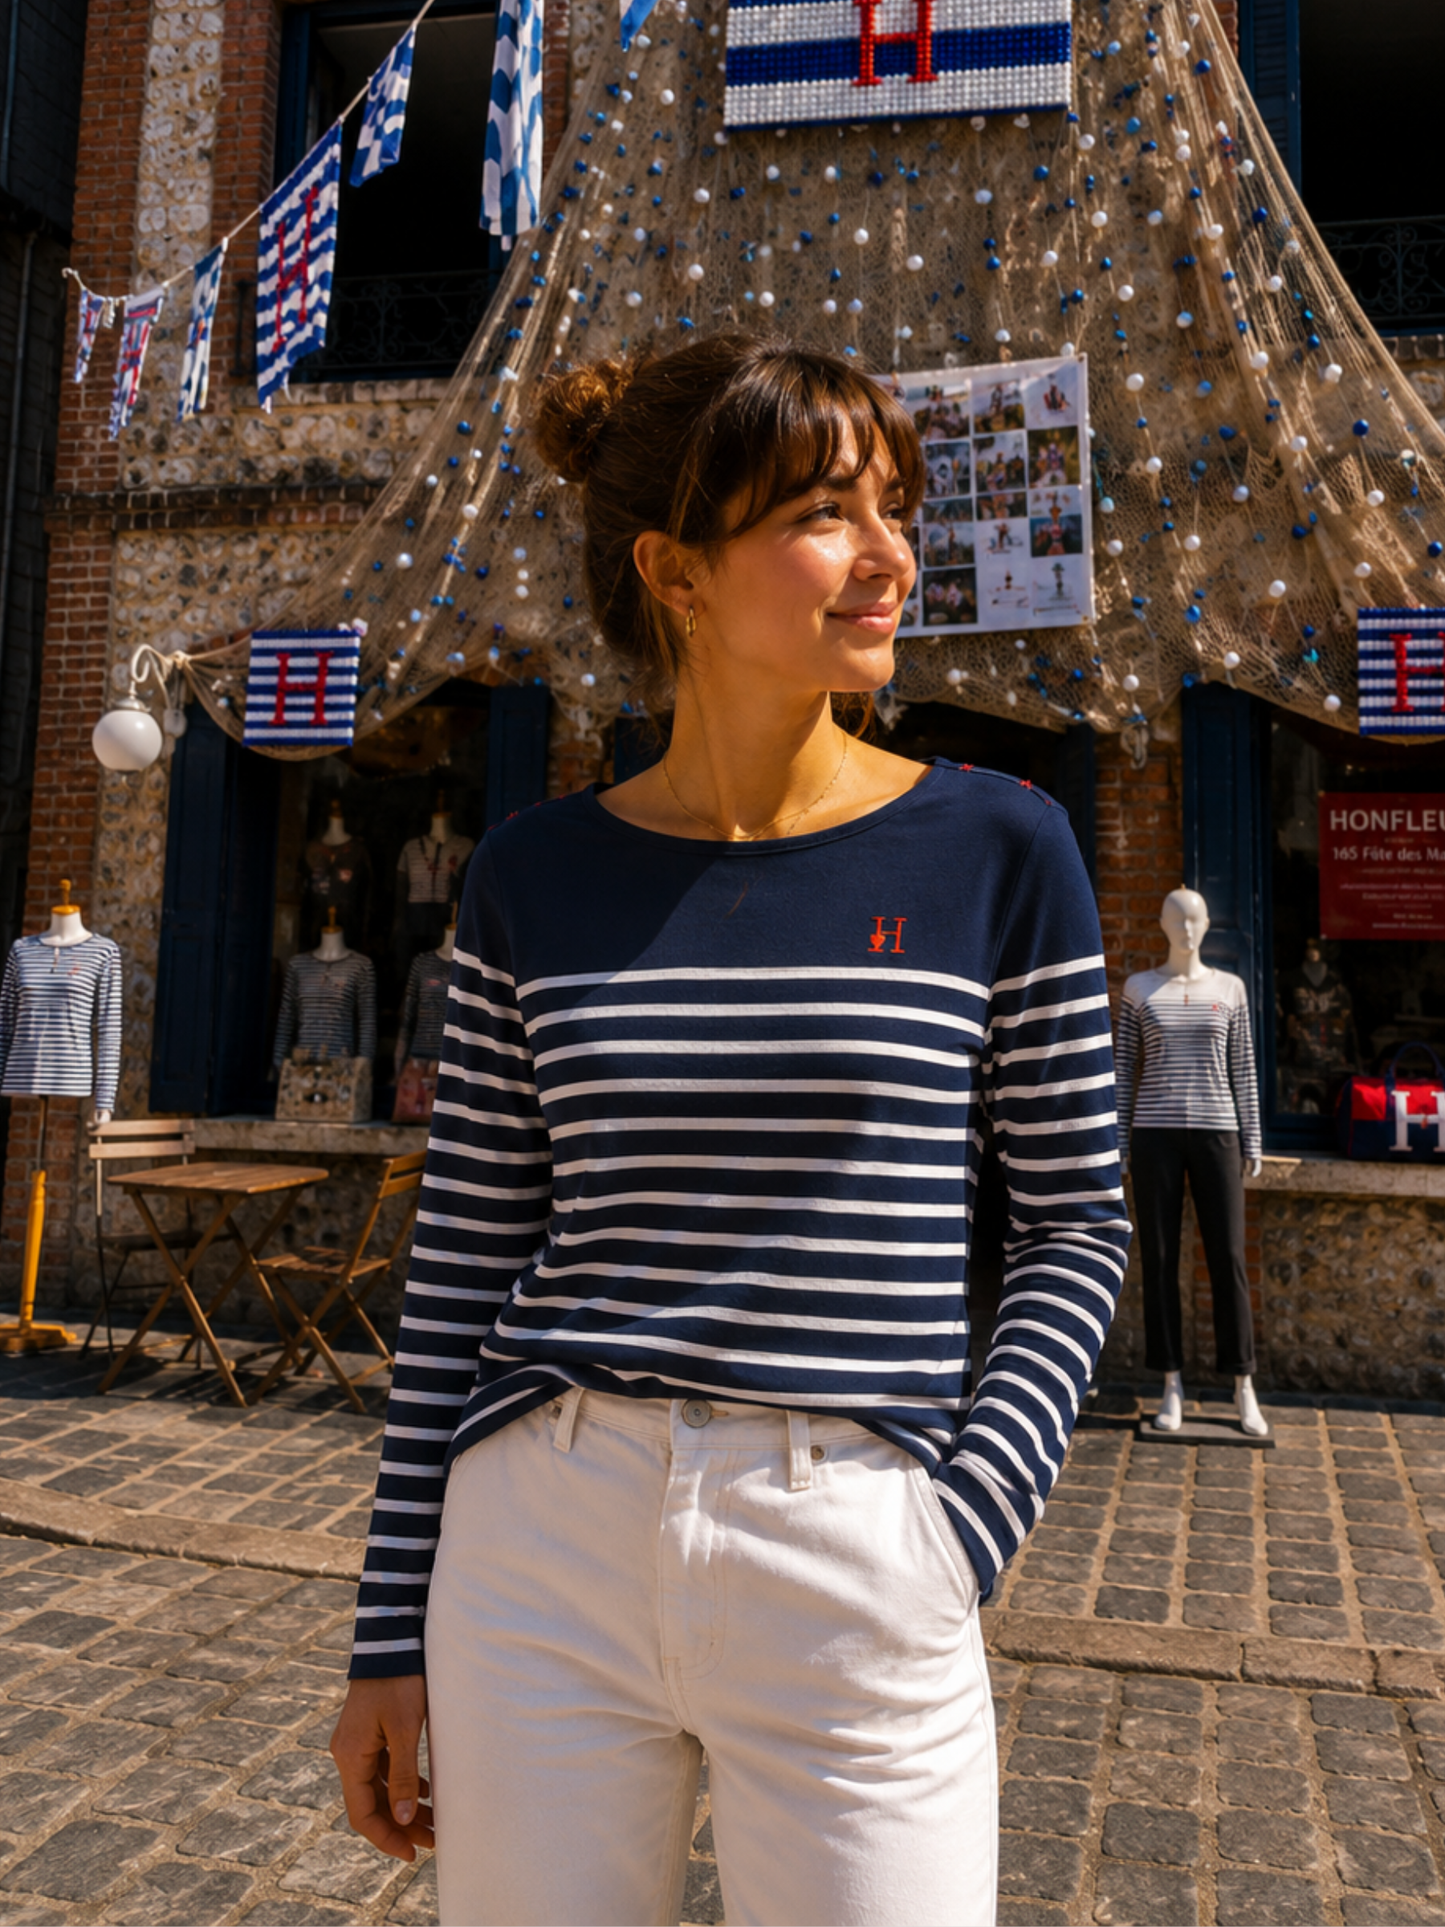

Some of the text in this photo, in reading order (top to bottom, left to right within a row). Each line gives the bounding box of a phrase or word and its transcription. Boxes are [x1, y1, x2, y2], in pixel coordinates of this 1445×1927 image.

[851, 0, 939, 85] H
[268, 649, 335, 726] H
[1397, 846, 1422, 861] des
[867, 916, 908, 954] H
[1388, 1090, 1445, 1152] H
